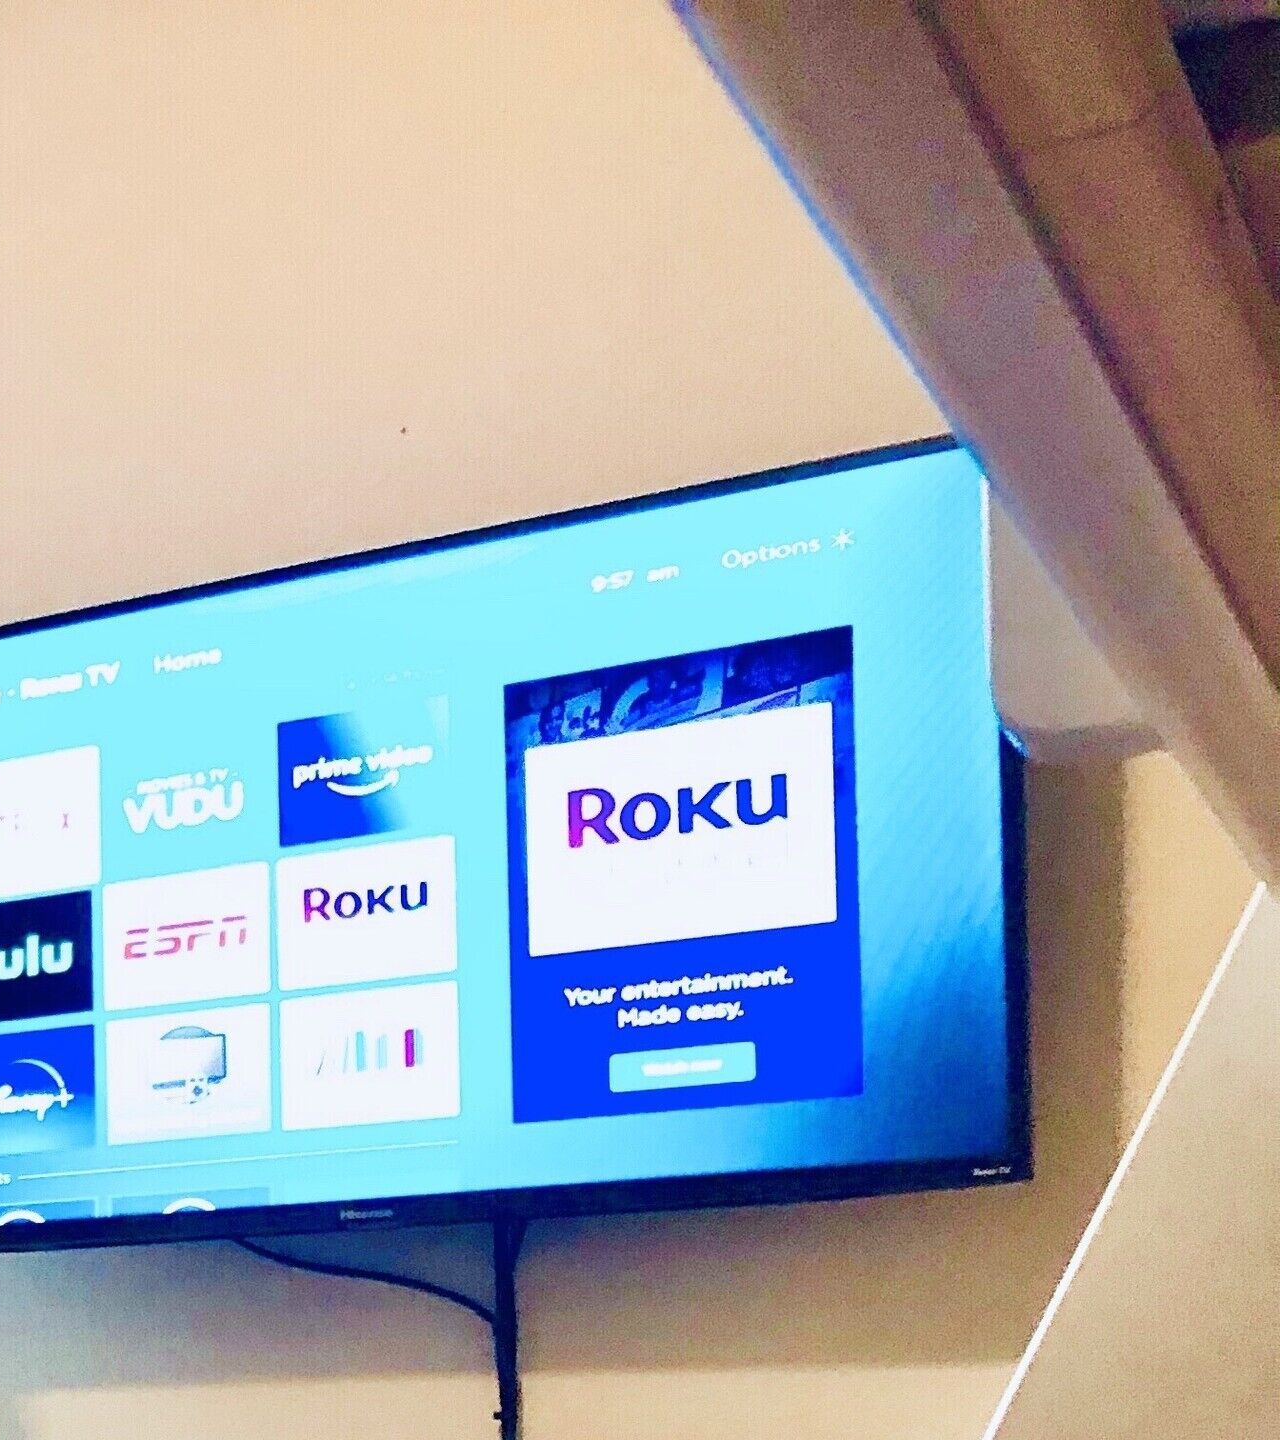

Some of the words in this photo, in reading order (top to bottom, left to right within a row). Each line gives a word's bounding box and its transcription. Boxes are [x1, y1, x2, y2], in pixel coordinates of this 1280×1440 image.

[721, 538, 820, 569] Options
[86, 661, 121, 687] TV
[153, 648, 222, 673] Home
[293, 755, 362, 789] prime
[364, 744, 433, 771] video
[123, 780, 244, 833] VUDU
[124, 915, 247, 960] ESPN
[564, 987, 617, 1007] Your
[621, 966, 793, 1001] entertainment.
[617, 1004, 681, 1028] Made
[686, 1001, 744, 1021] easy.
